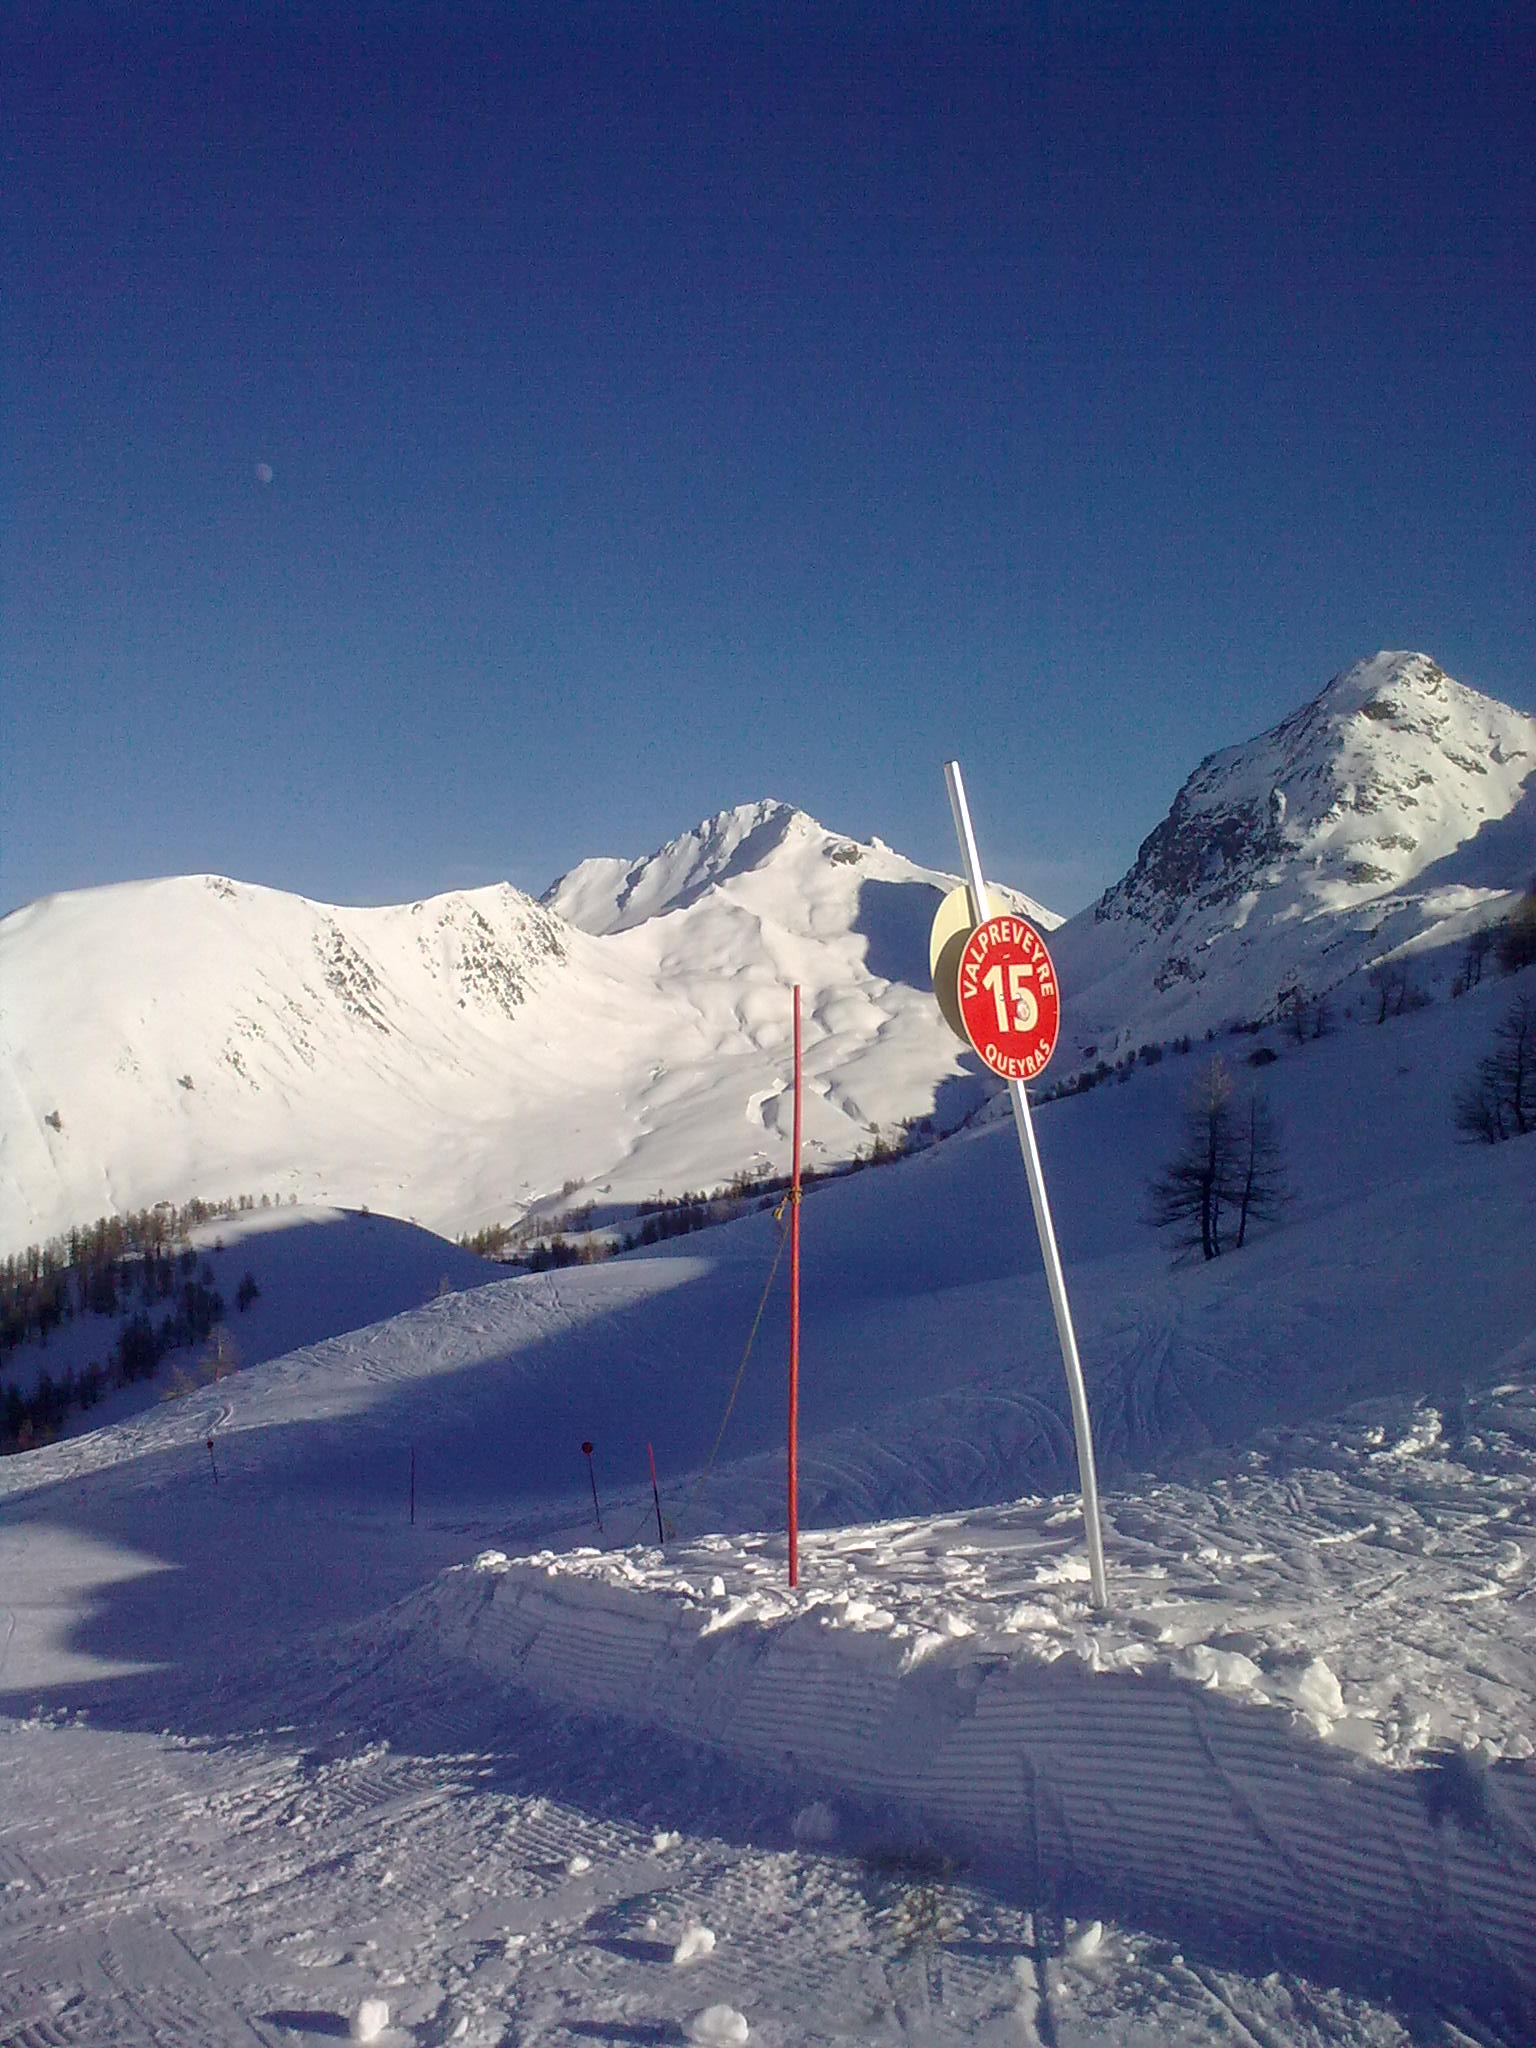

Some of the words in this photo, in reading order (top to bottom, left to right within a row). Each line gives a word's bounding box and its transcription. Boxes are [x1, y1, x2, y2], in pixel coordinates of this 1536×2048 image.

[964, 921, 1054, 998] VALPREVEYRE
[982, 964, 1038, 1032] 15
[985, 1038, 1051, 1076] QUEYRAS
